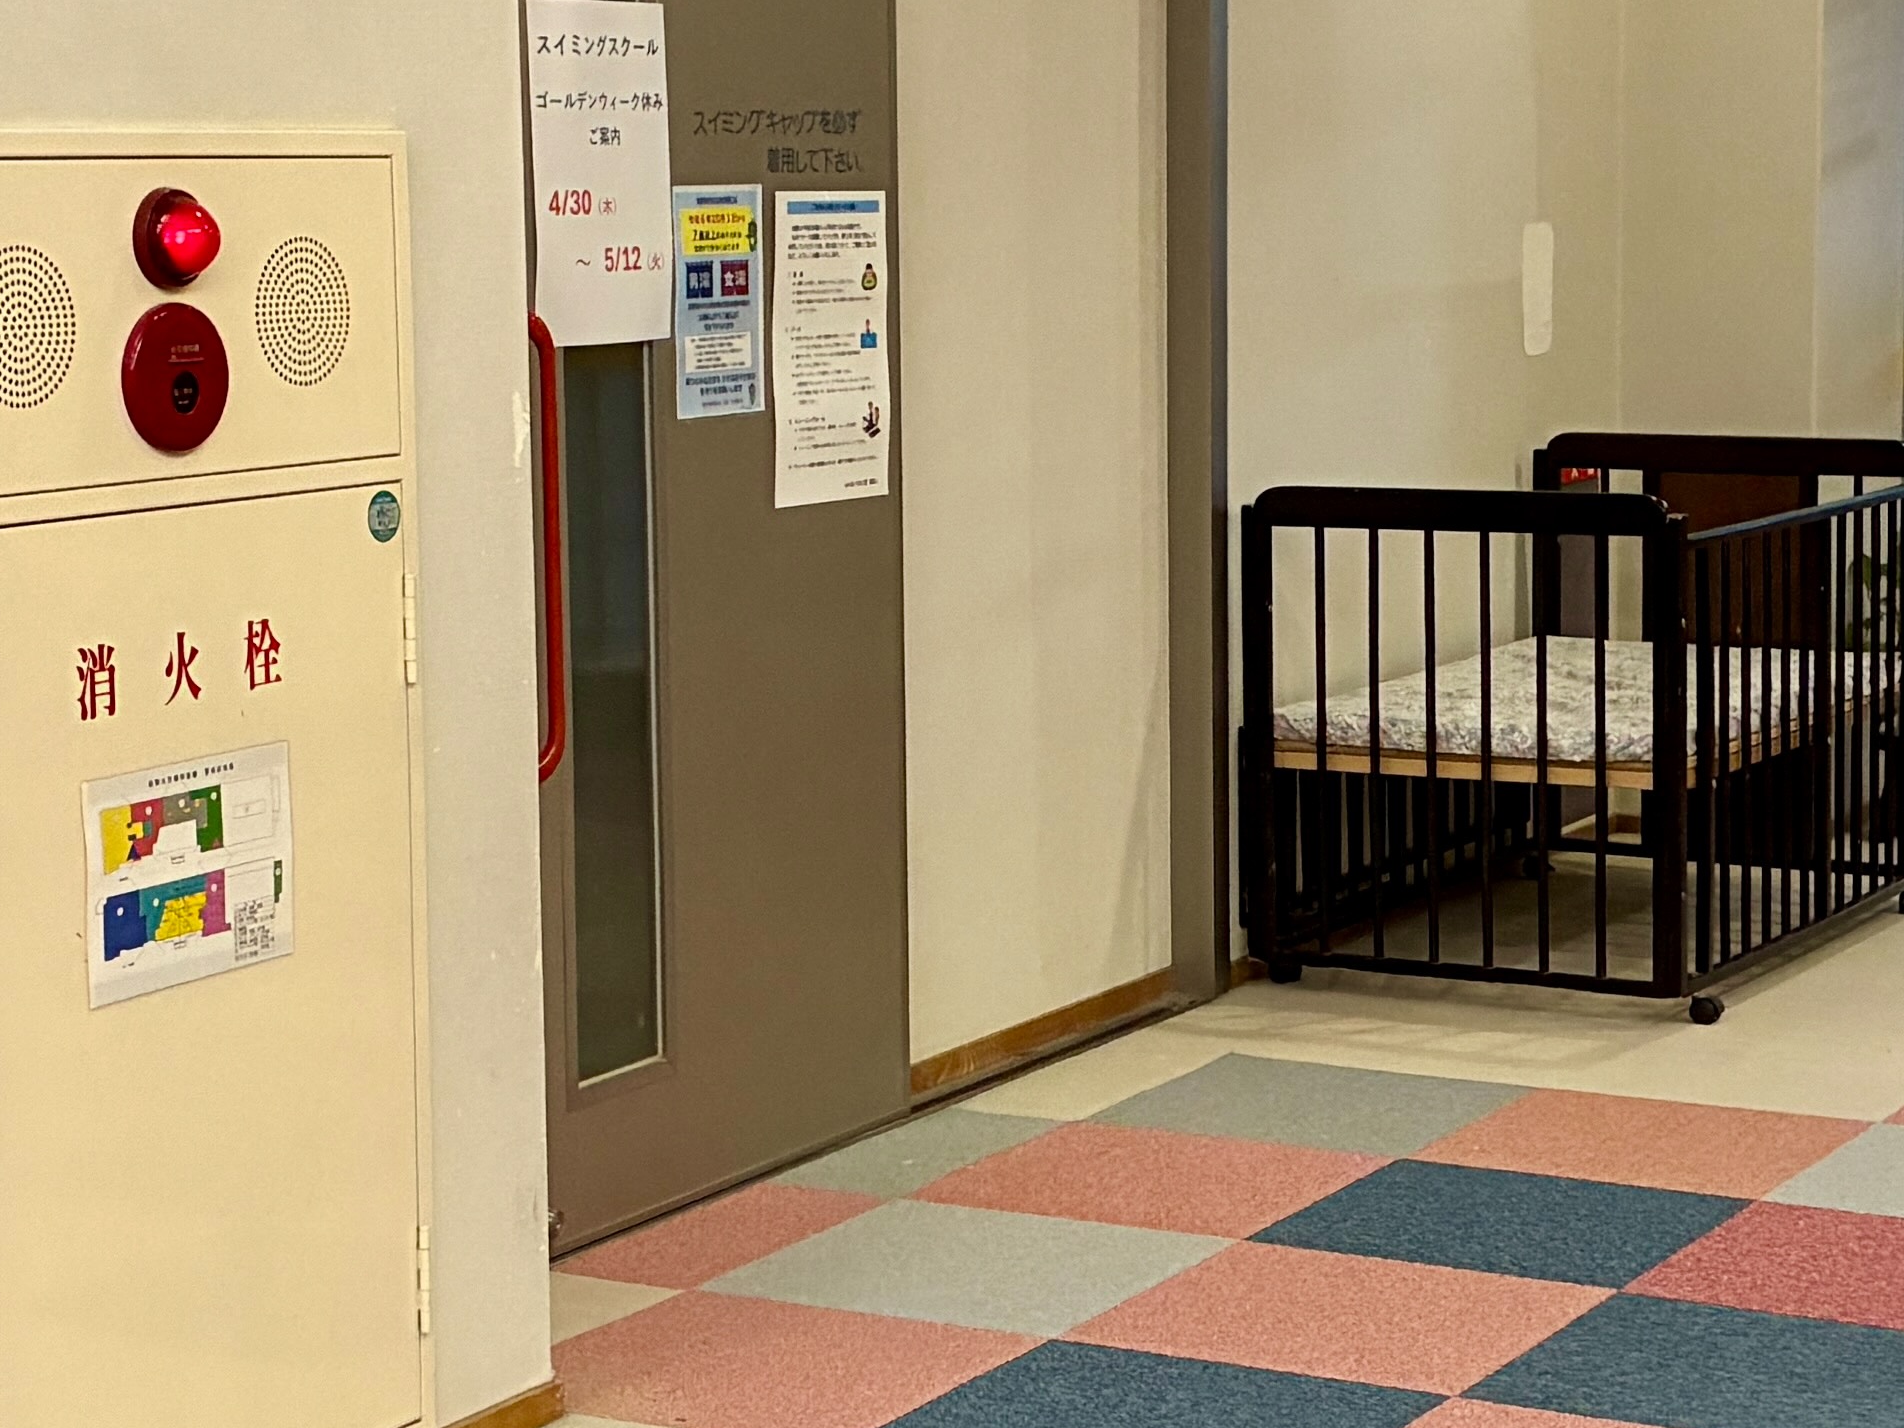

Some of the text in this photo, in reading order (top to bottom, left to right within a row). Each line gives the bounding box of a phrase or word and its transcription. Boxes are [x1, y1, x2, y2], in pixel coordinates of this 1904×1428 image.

[537, 33, 659, 57] スイミングスクール
[535, 91, 664, 112] ゴールデンウィーク休み
[589, 126, 621, 146] ご案内
[548, 189, 593, 216] 4/30
[604, 246, 642, 272] 5/12
[76, 618, 283, 721] 消火栓
